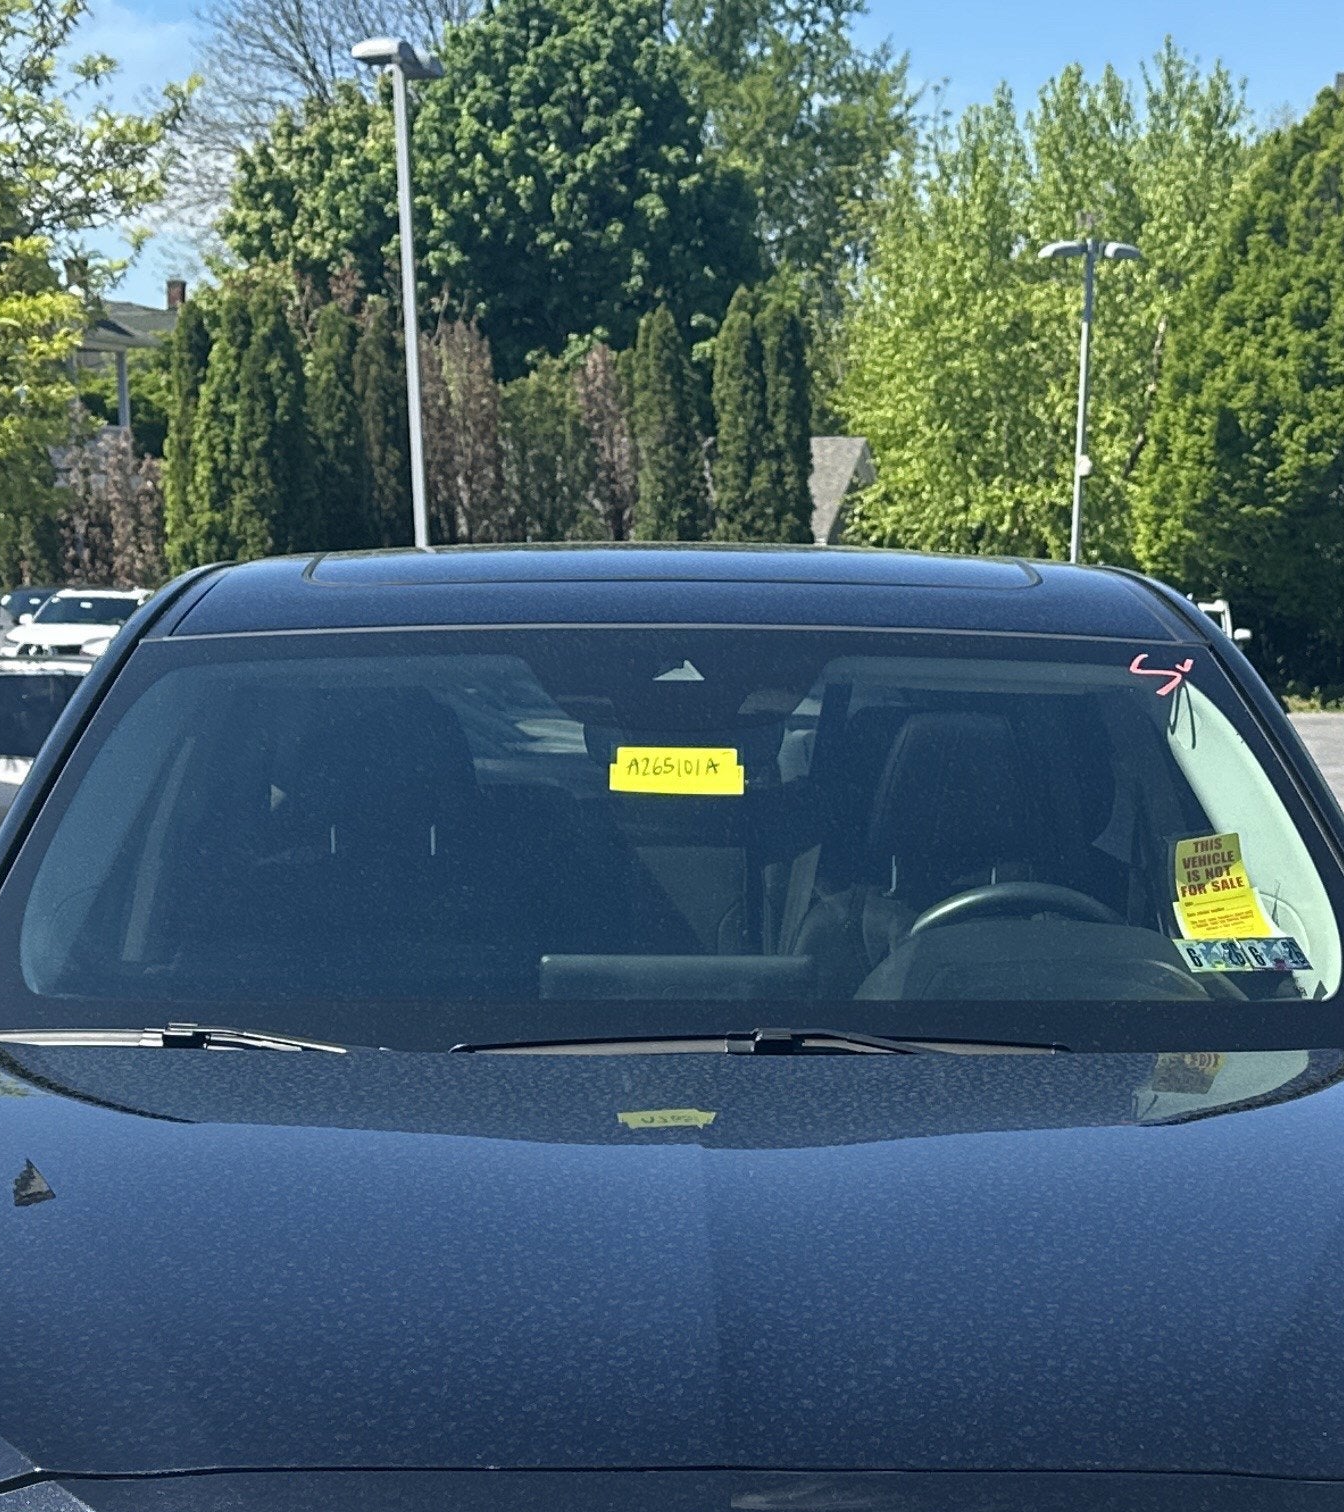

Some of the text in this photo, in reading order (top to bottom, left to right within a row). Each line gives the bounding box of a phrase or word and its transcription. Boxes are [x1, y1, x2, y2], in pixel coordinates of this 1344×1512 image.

[1192, 837, 1223, 853] THIS
[1182, 850, 1235, 869] VEHICLE
[1186, 864, 1232, 883] IS NOT
[1180, 876, 1245, 898] FOR SALE
[1186, 947, 1204, 968] 6
[1248, 945, 1266, 967] 6
